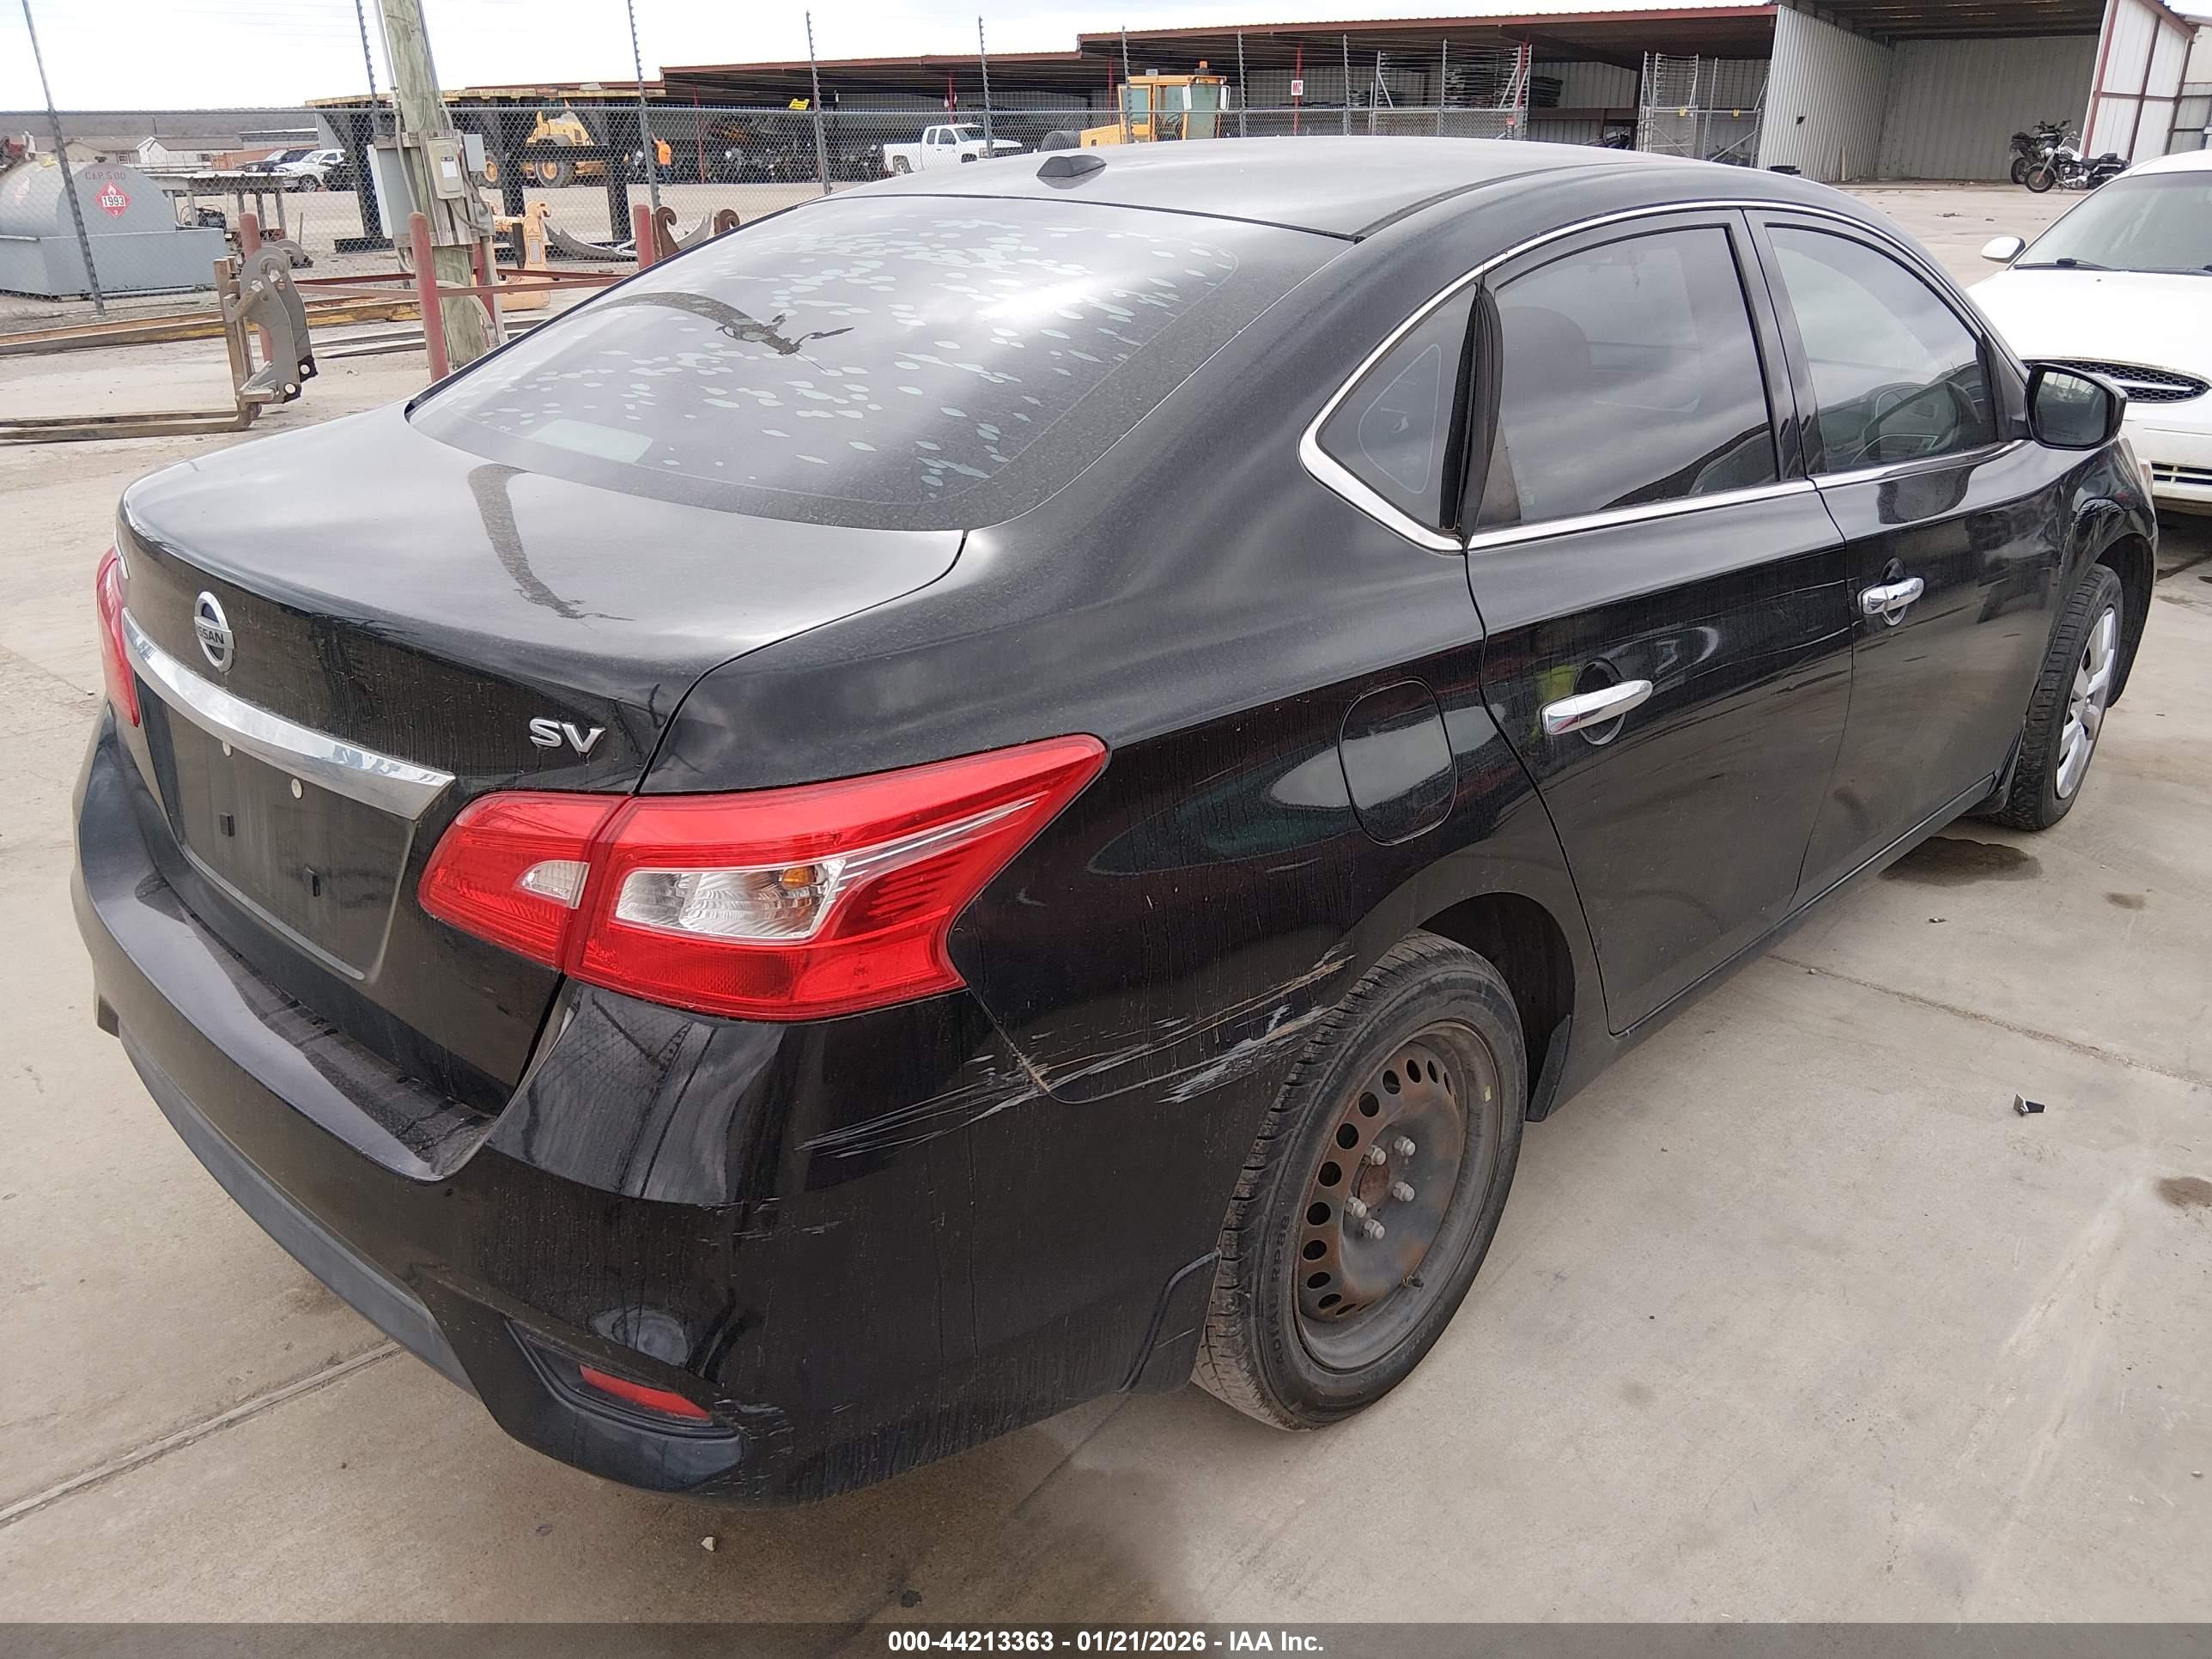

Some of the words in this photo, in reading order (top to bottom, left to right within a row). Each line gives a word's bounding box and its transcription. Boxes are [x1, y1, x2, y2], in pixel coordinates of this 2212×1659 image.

[1292, 82, 1302, 94] MC
[103, 196, 125, 207] 1993
[529, 718, 606, 753] SV
